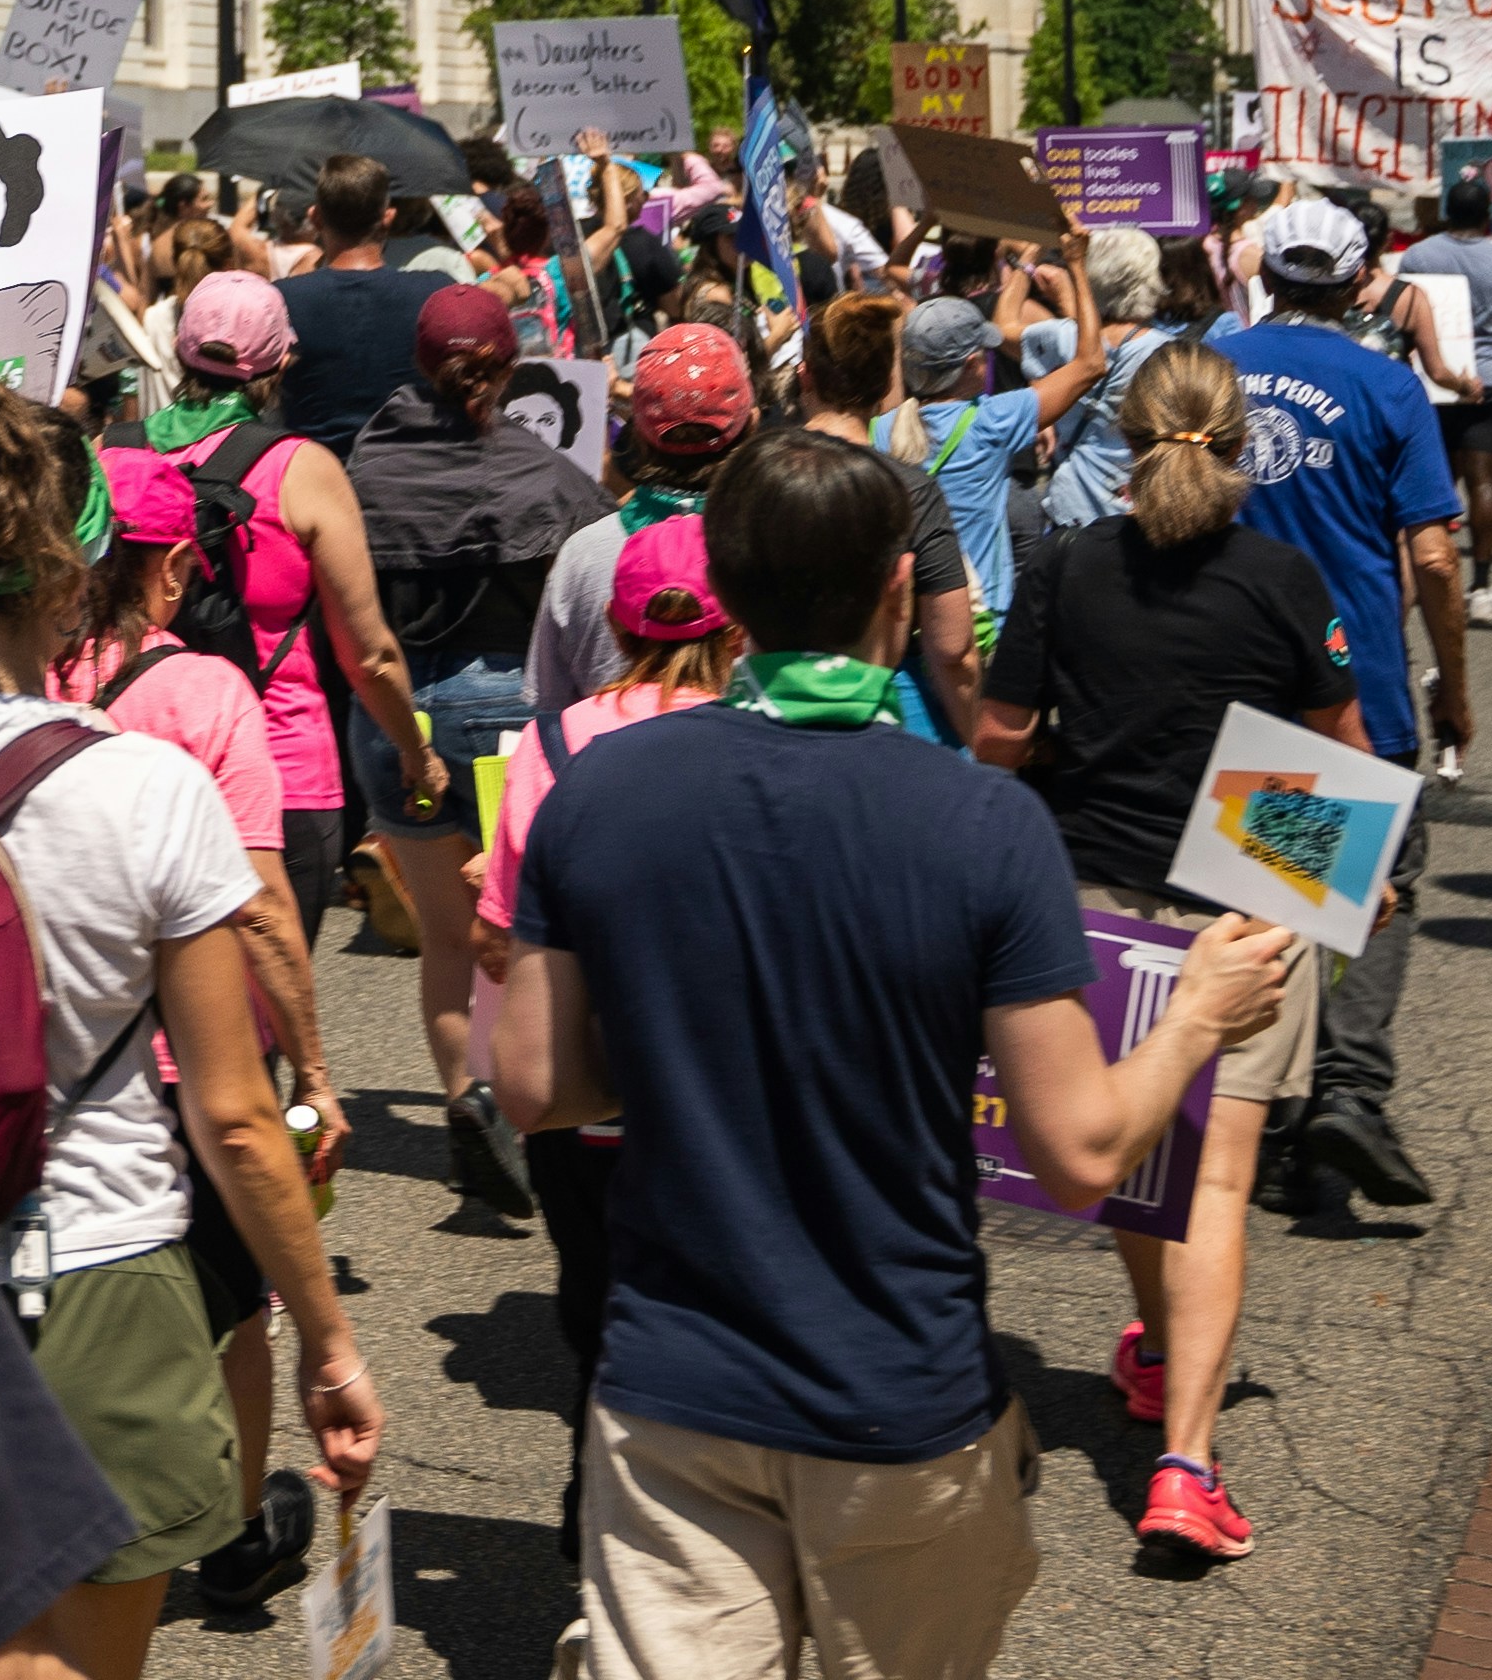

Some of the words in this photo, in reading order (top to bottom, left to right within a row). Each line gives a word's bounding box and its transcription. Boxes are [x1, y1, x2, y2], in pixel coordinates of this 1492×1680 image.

[44, 22, 85, 47] MY
[5, 31, 88, 81] BOX!
[533, 29, 645, 77] Daughters
[925, 47, 966, 64] MY
[511, 78, 580, 97] deserve
[591, 74, 660, 95] better
[905, 65, 985, 91] BODY
[921, 94, 964, 115] MY
[1046, 148, 1081, 162] OUR
[1084, 146, 1139, 162] bodies
[1047, 166, 1082, 180] OUR
[1084, 164, 1121, 180] lives
[1085, 180, 1161, 197] decisions
[1086, 198, 1142, 214] COURT
